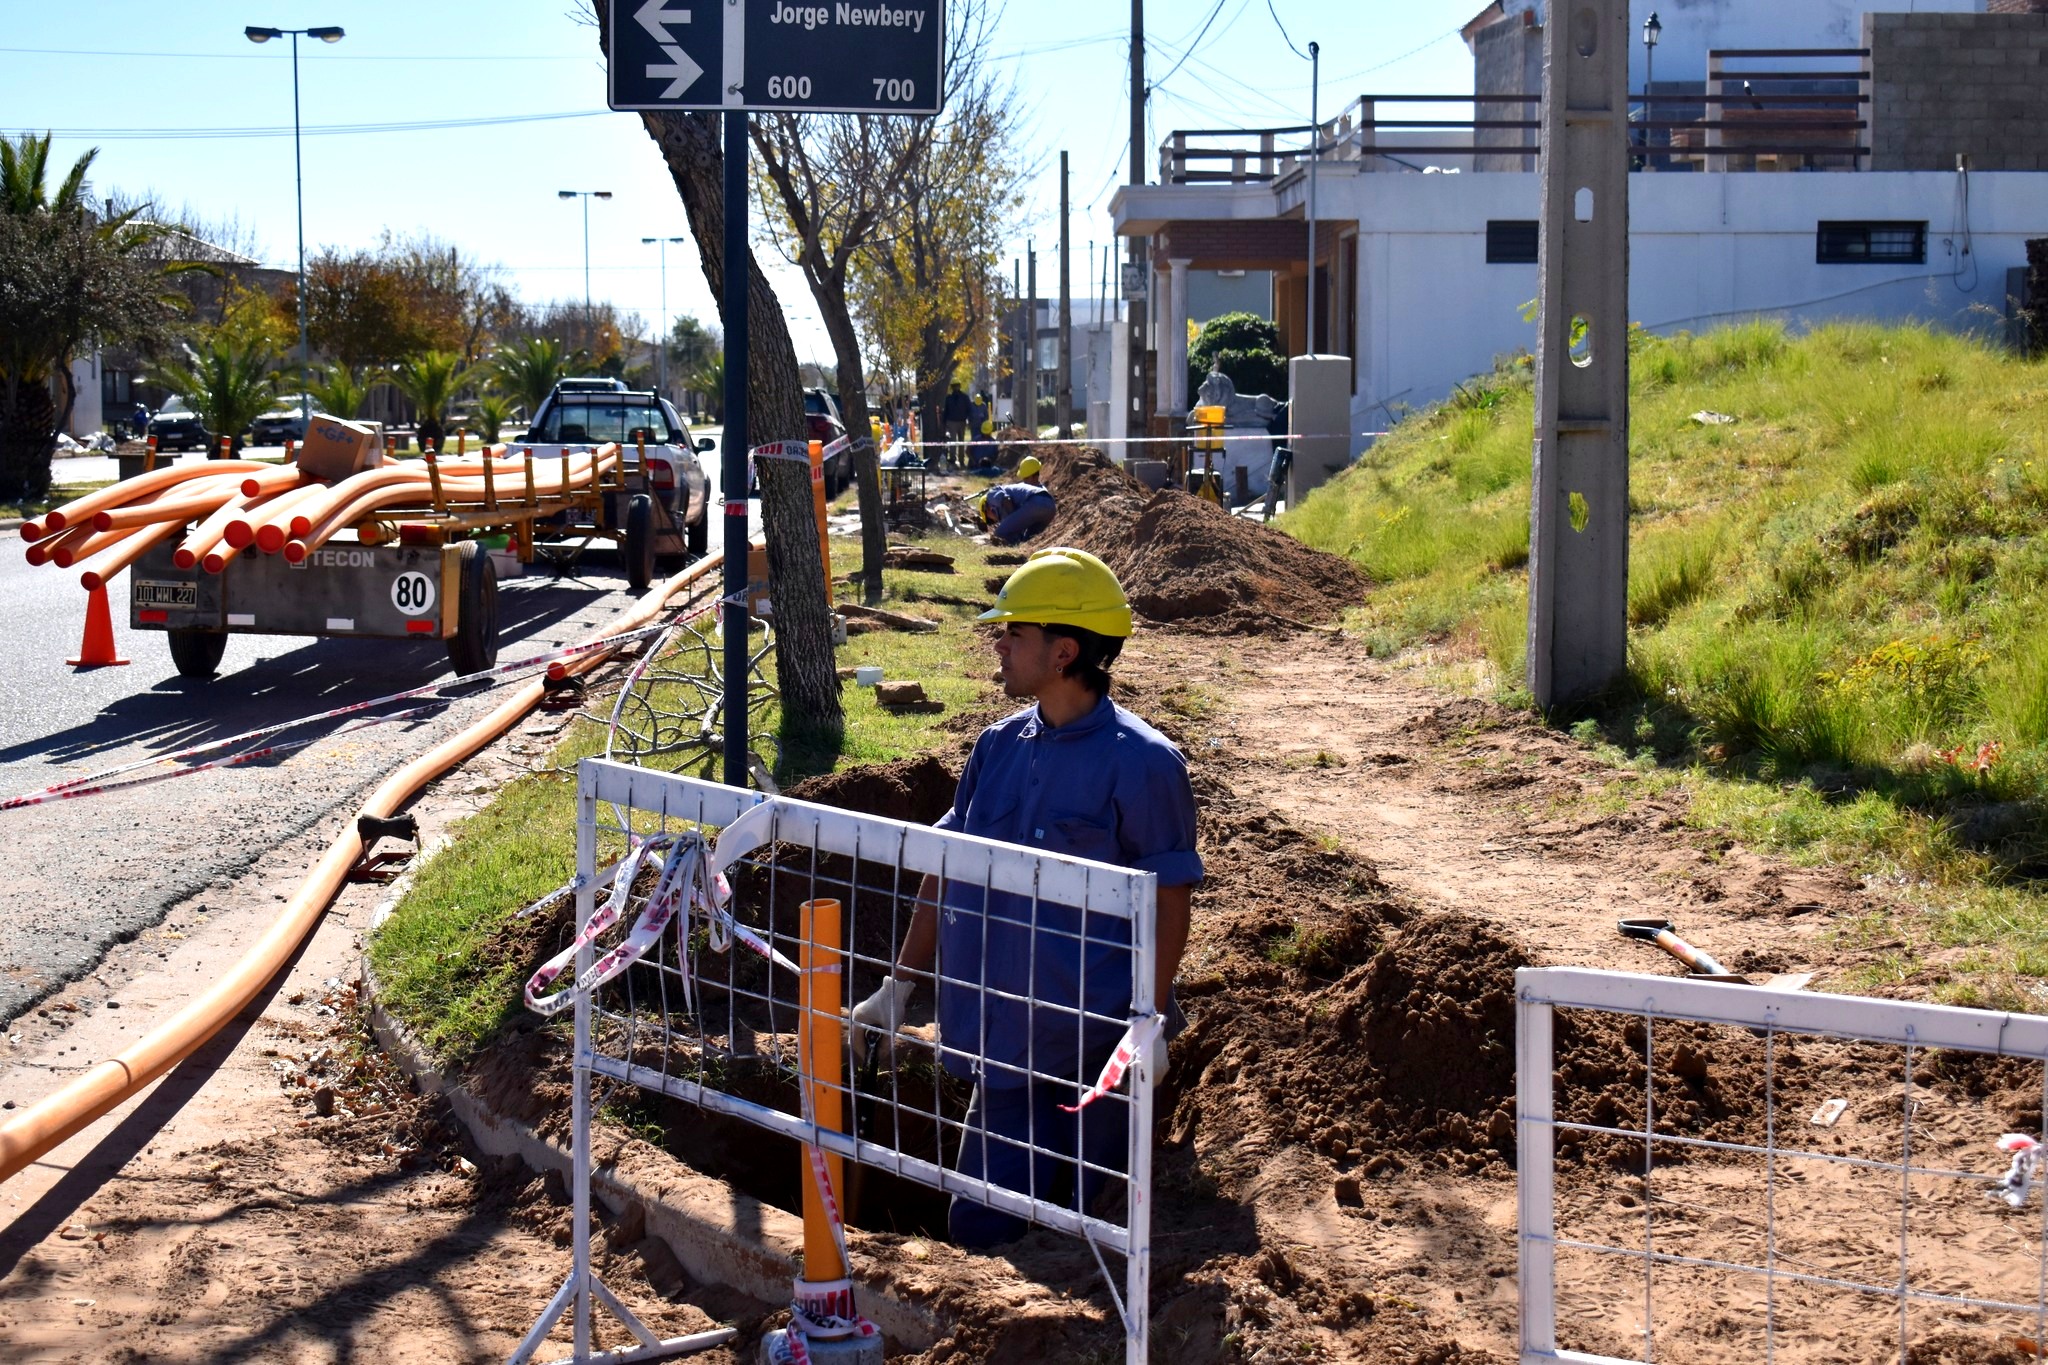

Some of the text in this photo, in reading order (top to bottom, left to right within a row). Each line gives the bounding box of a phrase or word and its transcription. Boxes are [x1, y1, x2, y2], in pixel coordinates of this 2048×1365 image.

[770, 1, 925, 33] Jorge Newbery
[767, 76, 812, 99] 600
[872, 78, 915, 102] 700
[312, 550, 375, 568] TECON
[176, 588, 194, 604] 227
[396, 576, 427, 608] 80
